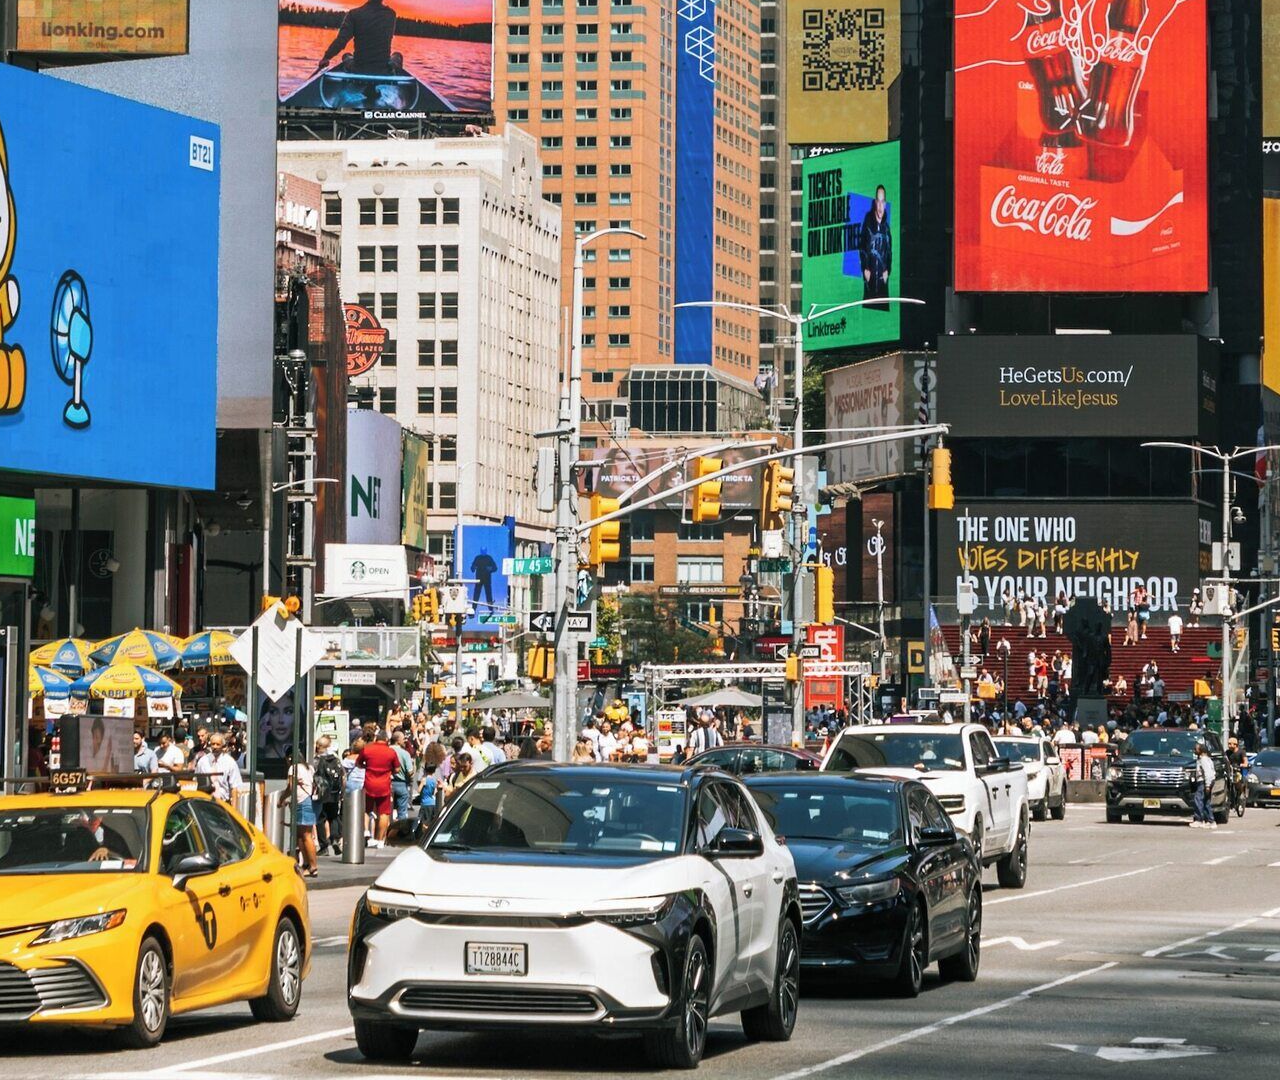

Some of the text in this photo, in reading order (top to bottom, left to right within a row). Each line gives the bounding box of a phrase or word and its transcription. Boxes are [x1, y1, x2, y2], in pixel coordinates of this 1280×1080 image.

[41, 21, 165, 42] lionking.com
[373, 110, 427, 120] CLEAR CHANNEL
[191, 142, 212, 165] BT21
[807, 168, 842, 200] TICKETS
[1018, 174, 1070, 189] ORIGINAL TASTE
[807, 195, 851, 228] AVAILABLE
[807, 228, 821, 258] ON
[807, 321, 841, 339] Linktree
[999, 364, 1135, 388] HeGetsUs.com/
[834, 382, 893, 416] MISSIONARY STYLE
[999, 389, 1119, 410] LoveLikeJesus
[957, 516, 1076, 543] THE ONE WHO
[515, 558, 552, 572] W 45 St
[957, 545, 1140, 573] VOTES DIFFERENTLY
[368, 566, 389, 575] OPEN
[52, 773, 82, 785] 6G57
[473, 951, 519, 967] T128844C
